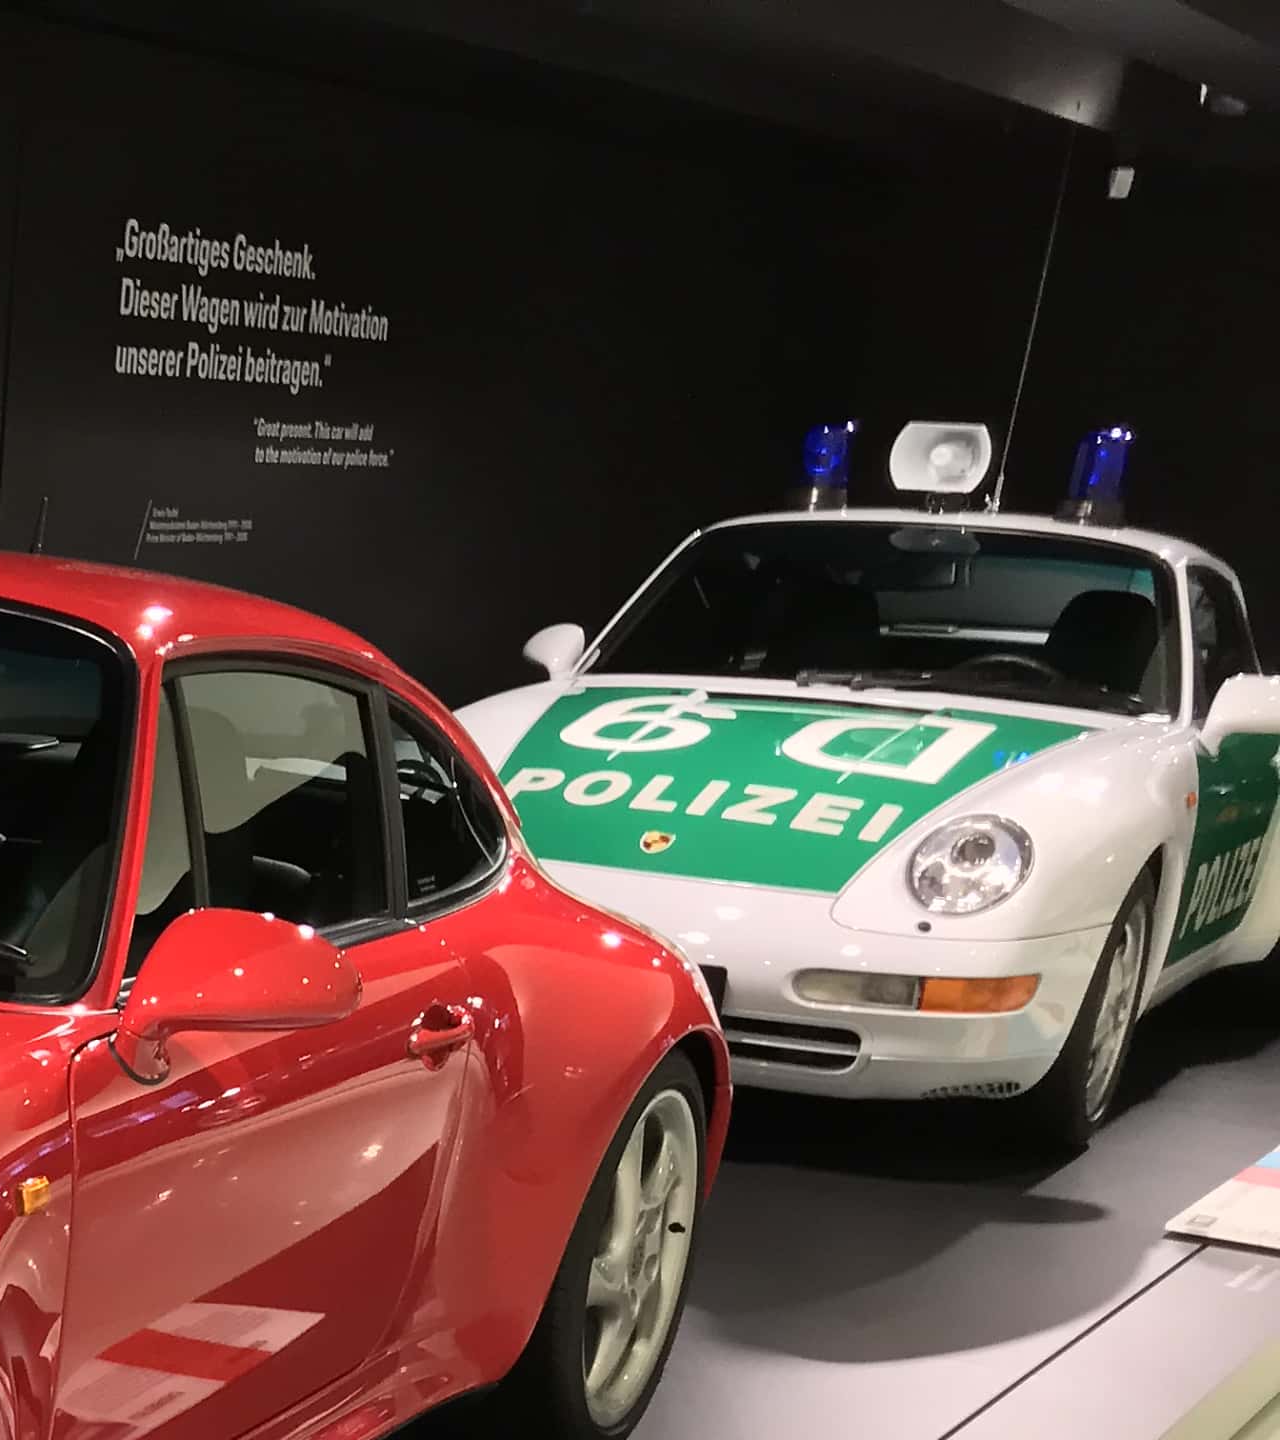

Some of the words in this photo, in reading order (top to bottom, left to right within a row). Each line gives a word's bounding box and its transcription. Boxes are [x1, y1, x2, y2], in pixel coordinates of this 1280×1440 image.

[232, 233, 316, 280] Geschenk.
[120, 277, 179, 320] Dieser
[182, 284, 240, 333] Wagen
[243, 293, 280, 331] wird
[282, 305, 307, 333] zur
[309, 299, 389, 341] Motivation
[115, 344, 184, 378] unserer
[187, 341, 242, 382] Polizei
[314, 420, 331, 440] This
[331, 426, 344, 441] car
[344, 422, 359, 441] will
[358, 424, 374, 442] add
[254, 446, 265, 464] to
[265, 445, 279, 464] the
[280, 446, 322, 465] motivation
[322, 447, 332, 465] of
[344, 449, 368, 470] police
[506, 767, 903, 843] POLIZEI
[1178, 836, 1264, 939] POLIZEI
